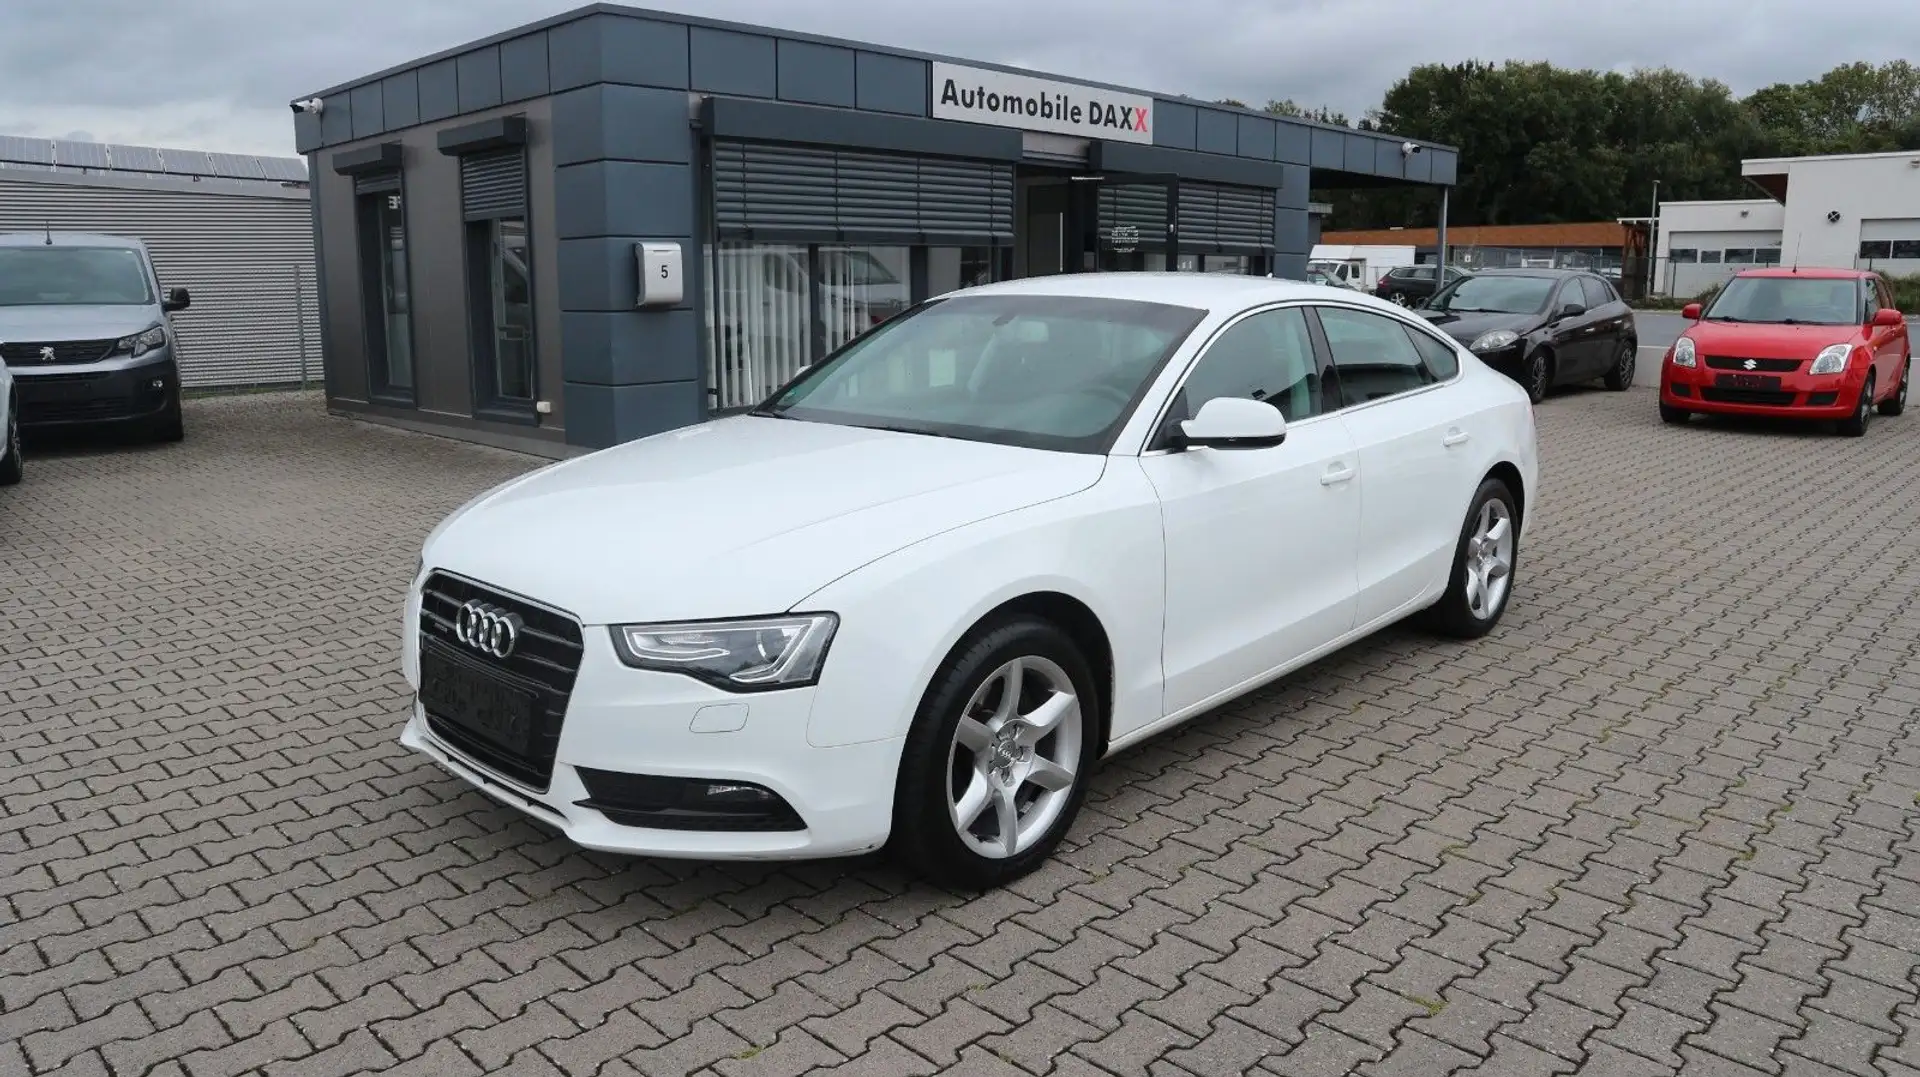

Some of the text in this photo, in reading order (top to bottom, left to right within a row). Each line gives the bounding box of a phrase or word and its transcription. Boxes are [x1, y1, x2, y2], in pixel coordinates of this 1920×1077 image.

[941, 79, 1148, 132] Automobile DAXX
[661, 265, 669, 279] 5
